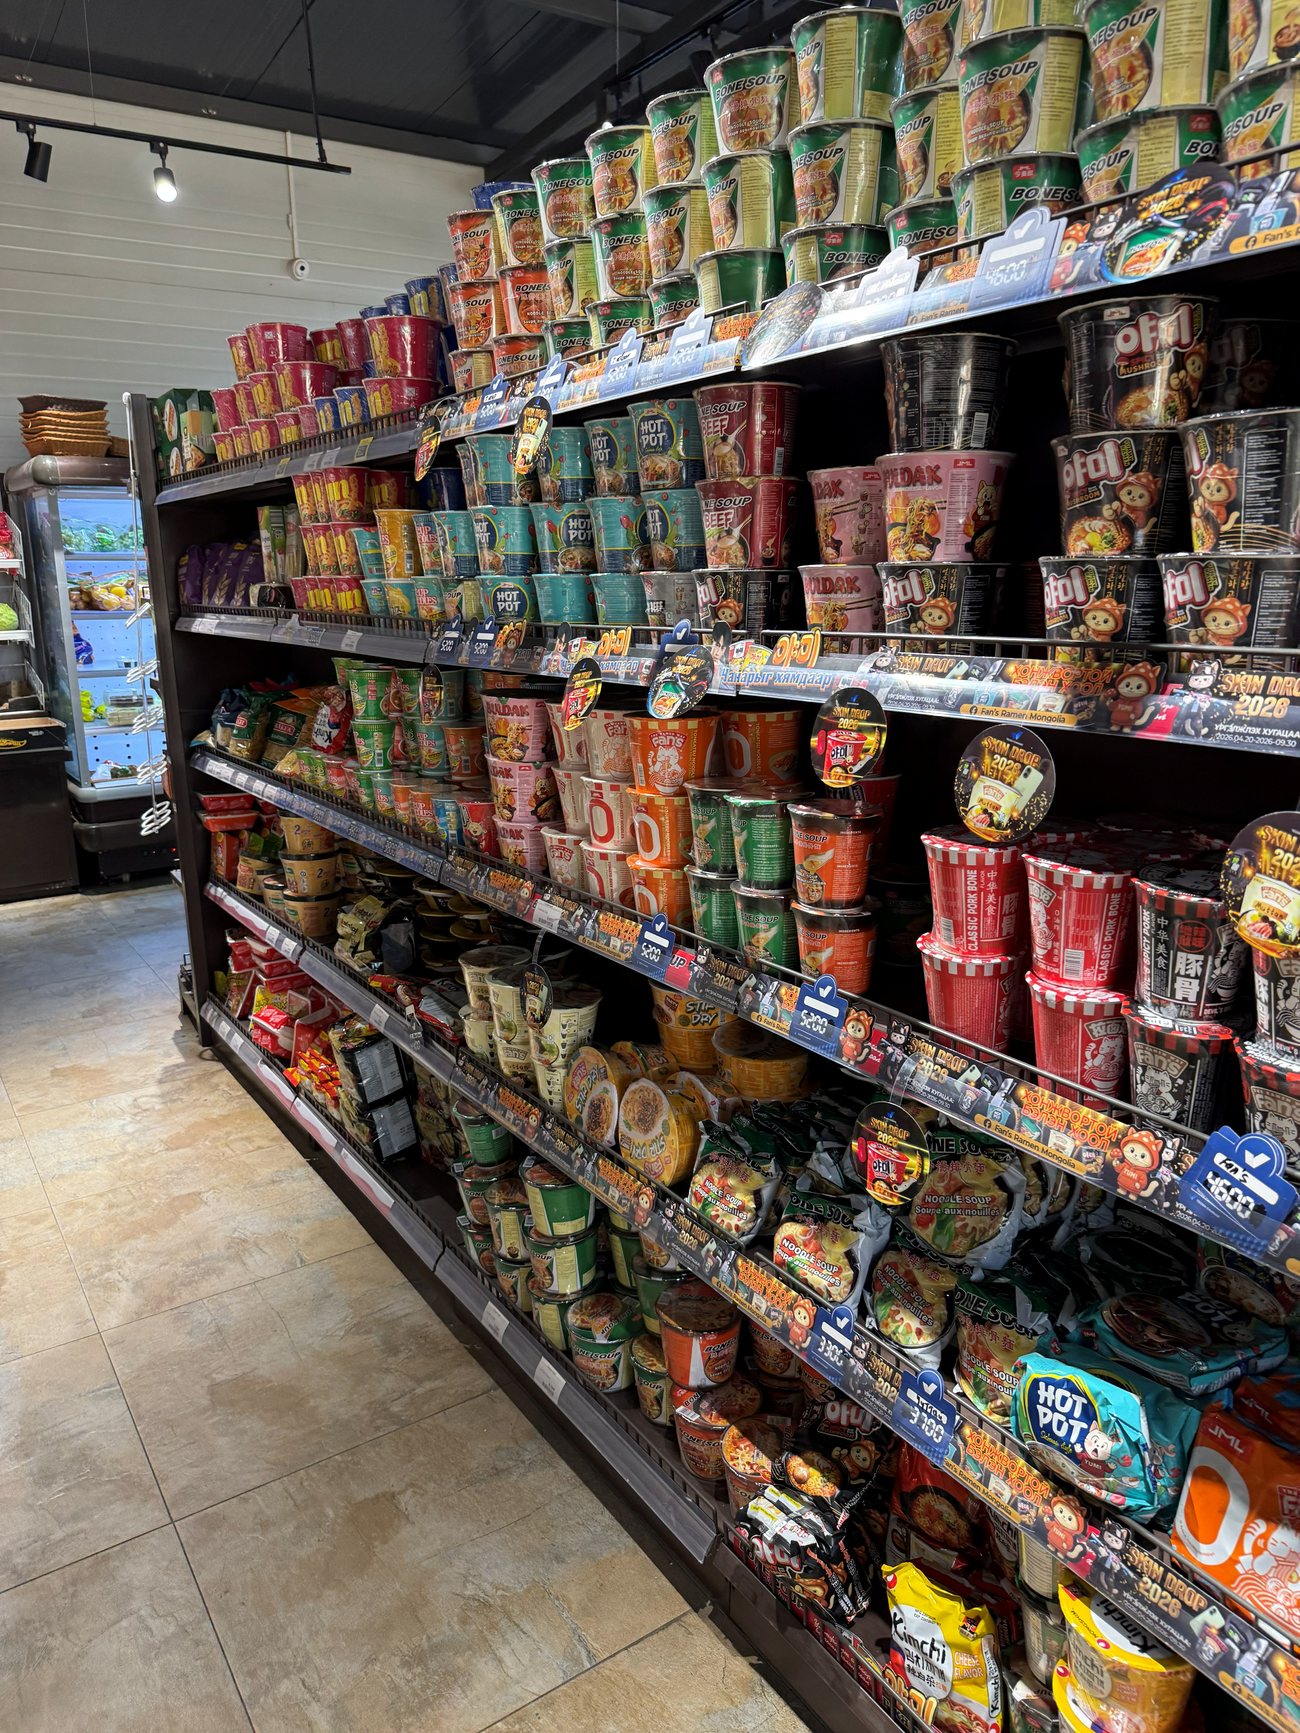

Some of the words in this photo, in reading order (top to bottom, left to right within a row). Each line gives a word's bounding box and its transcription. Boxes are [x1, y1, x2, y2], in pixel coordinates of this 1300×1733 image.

[746, 74, 786, 88] SOUP
[987, 60, 1039, 85] SOUP
[607, 148, 640, 163] SOUP
[823, 251, 867, 266] BONE
[641, 419, 664, 433] HOT
[642, 433, 668, 447] POT
[568, 518, 592, 531] HOT
[568, 529, 593, 542] POT
[496, 590, 519, 602] HOT
[497, 601, 521, 613] POT
[923, 658, 956, 674] DROP
[1223, 674, 1265, 695] SKIN
[980, 708, 1000, 717] Fan's
[1000, 709, 1027, 721] Ramen
[1028, 712, 1066, 725] Mongolia
[1234, 696, 1290, 719] 2026
[837, 717, 859, 730] 2026
[991, 753, 1022, 774] 2026
[803, 833, 828, 843] SOUP
[966, 868, 978, 891] BONE
[985, 869, 998, 916] 中华美食
[967, 891, 978, 917] PORK
[1108, 892, 1121, 917] BONE
[967, 918, 979, 952] CLASSIC
[1104, 915, 1116, 942] PORK
[1155, 916, 1169, 970] 中华美食
[1098, 942, 1111, 982] CLASSIC
[1174, 951, 1205, 1002] 豚骨
[691, 1013, 719, 1026] DRY
[915, 1057, 948, 1084] 2026
[936, 1049, 969, 1074] DROP
[1137, 1049, 1183, 1078] Fan's
[1020, 1103, 1068, 1133] БЭЛЭН
[1068, 1124, 1111, 1153] ХООЛ
[1021, 1087, 1119, 1143] ХОНЖВОРТОЙ
[877, 1131, 899, 1148] 2026
[994, 1123, 1013, 1139] Fan's
[1013, 1132, 1041, 1151] Ramen
[1040, 1145, 1077, 1170] Mongolia
[704, 1177, 725, 1197] NOODLE
[724, 1190, 744, 1208] SOUP
[924, 1195, 963, 1204] NOODLE
[965, 1196, 993, 1205] SOUP
[943, 1207, 963, 1216] aux
[782, 1237, 816, 1264] NOODLE
[816, 1257, 840, 1274] SOUP
[793, 1259, 809, 1271] aux
[808, 1267, 842, 1287] nouilles
[884, 1264, 912, 1295] NOODLE
[901, 1296, 935, 1327] nouilles
[1038, 1381, 1088, 1420] HOT
[908, 1406, 945, 1444] 3700
[1036, 1404, 1089, 1444] POT
[1208, 1424, 1244, 1454] JML
[966, 1443, 1006, 1480] БЭЛЭН
[1006, 1472, 1043, 1508] ХООЛ
[967, 1428, 1052, 1500] ХОНЖВОРТОЙ
[958, 1469, 981, 1493] Ramen
[981, 1487, 1013, 1515] Mongolia
[1138, 1576, 1183, 1619] 2026
[1163, 1571, 1209, 1612] DROP
[892, 1611, 947, 1665] Kimchi
[1097, 1595, 1158, 1655] Kimchi
[953, 1651, 980, 1668] CHEESE
[953, 1667, 984, 1680] FLAVOR
[990, 1676, 1000, 1714] Kimchi
